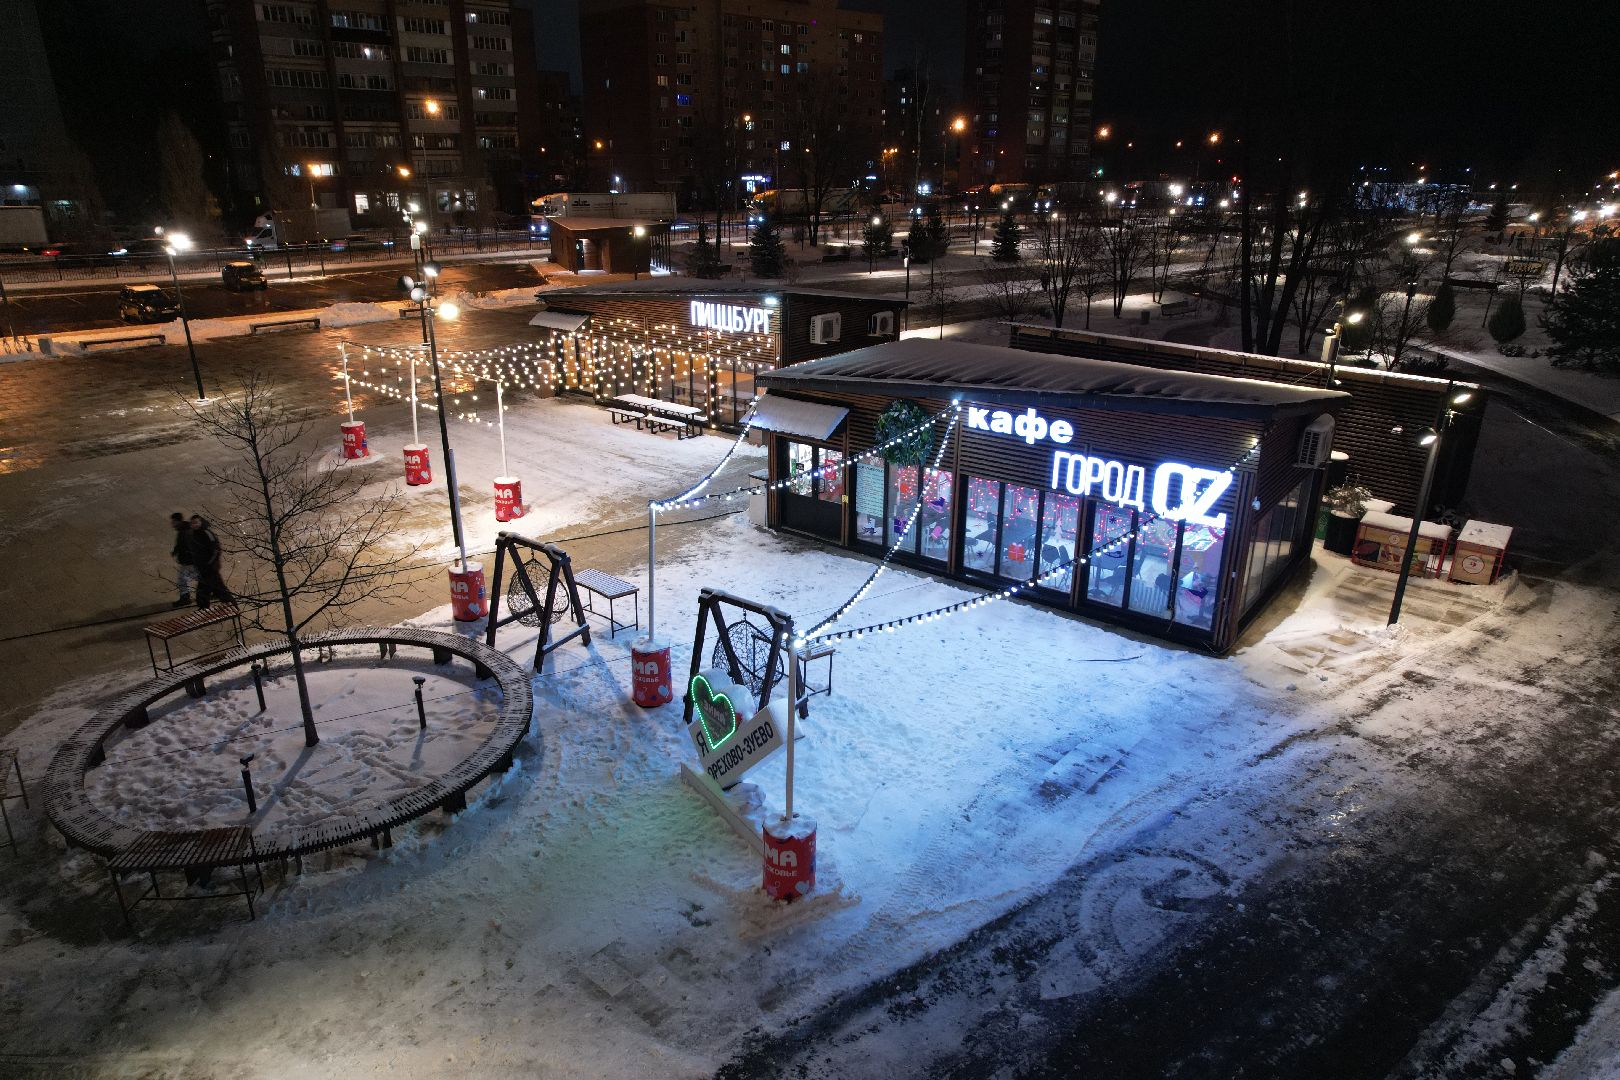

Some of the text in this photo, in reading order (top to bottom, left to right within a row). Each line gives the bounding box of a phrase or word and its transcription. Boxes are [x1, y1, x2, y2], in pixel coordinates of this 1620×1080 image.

[690, 301, 774, 334] ПИЦЦБУРГ
[967, 407, 1074, 444] кафе
[1051, 450, 1233, 528] ГОРОД OZ
[695, 730, 709, 758] Я
